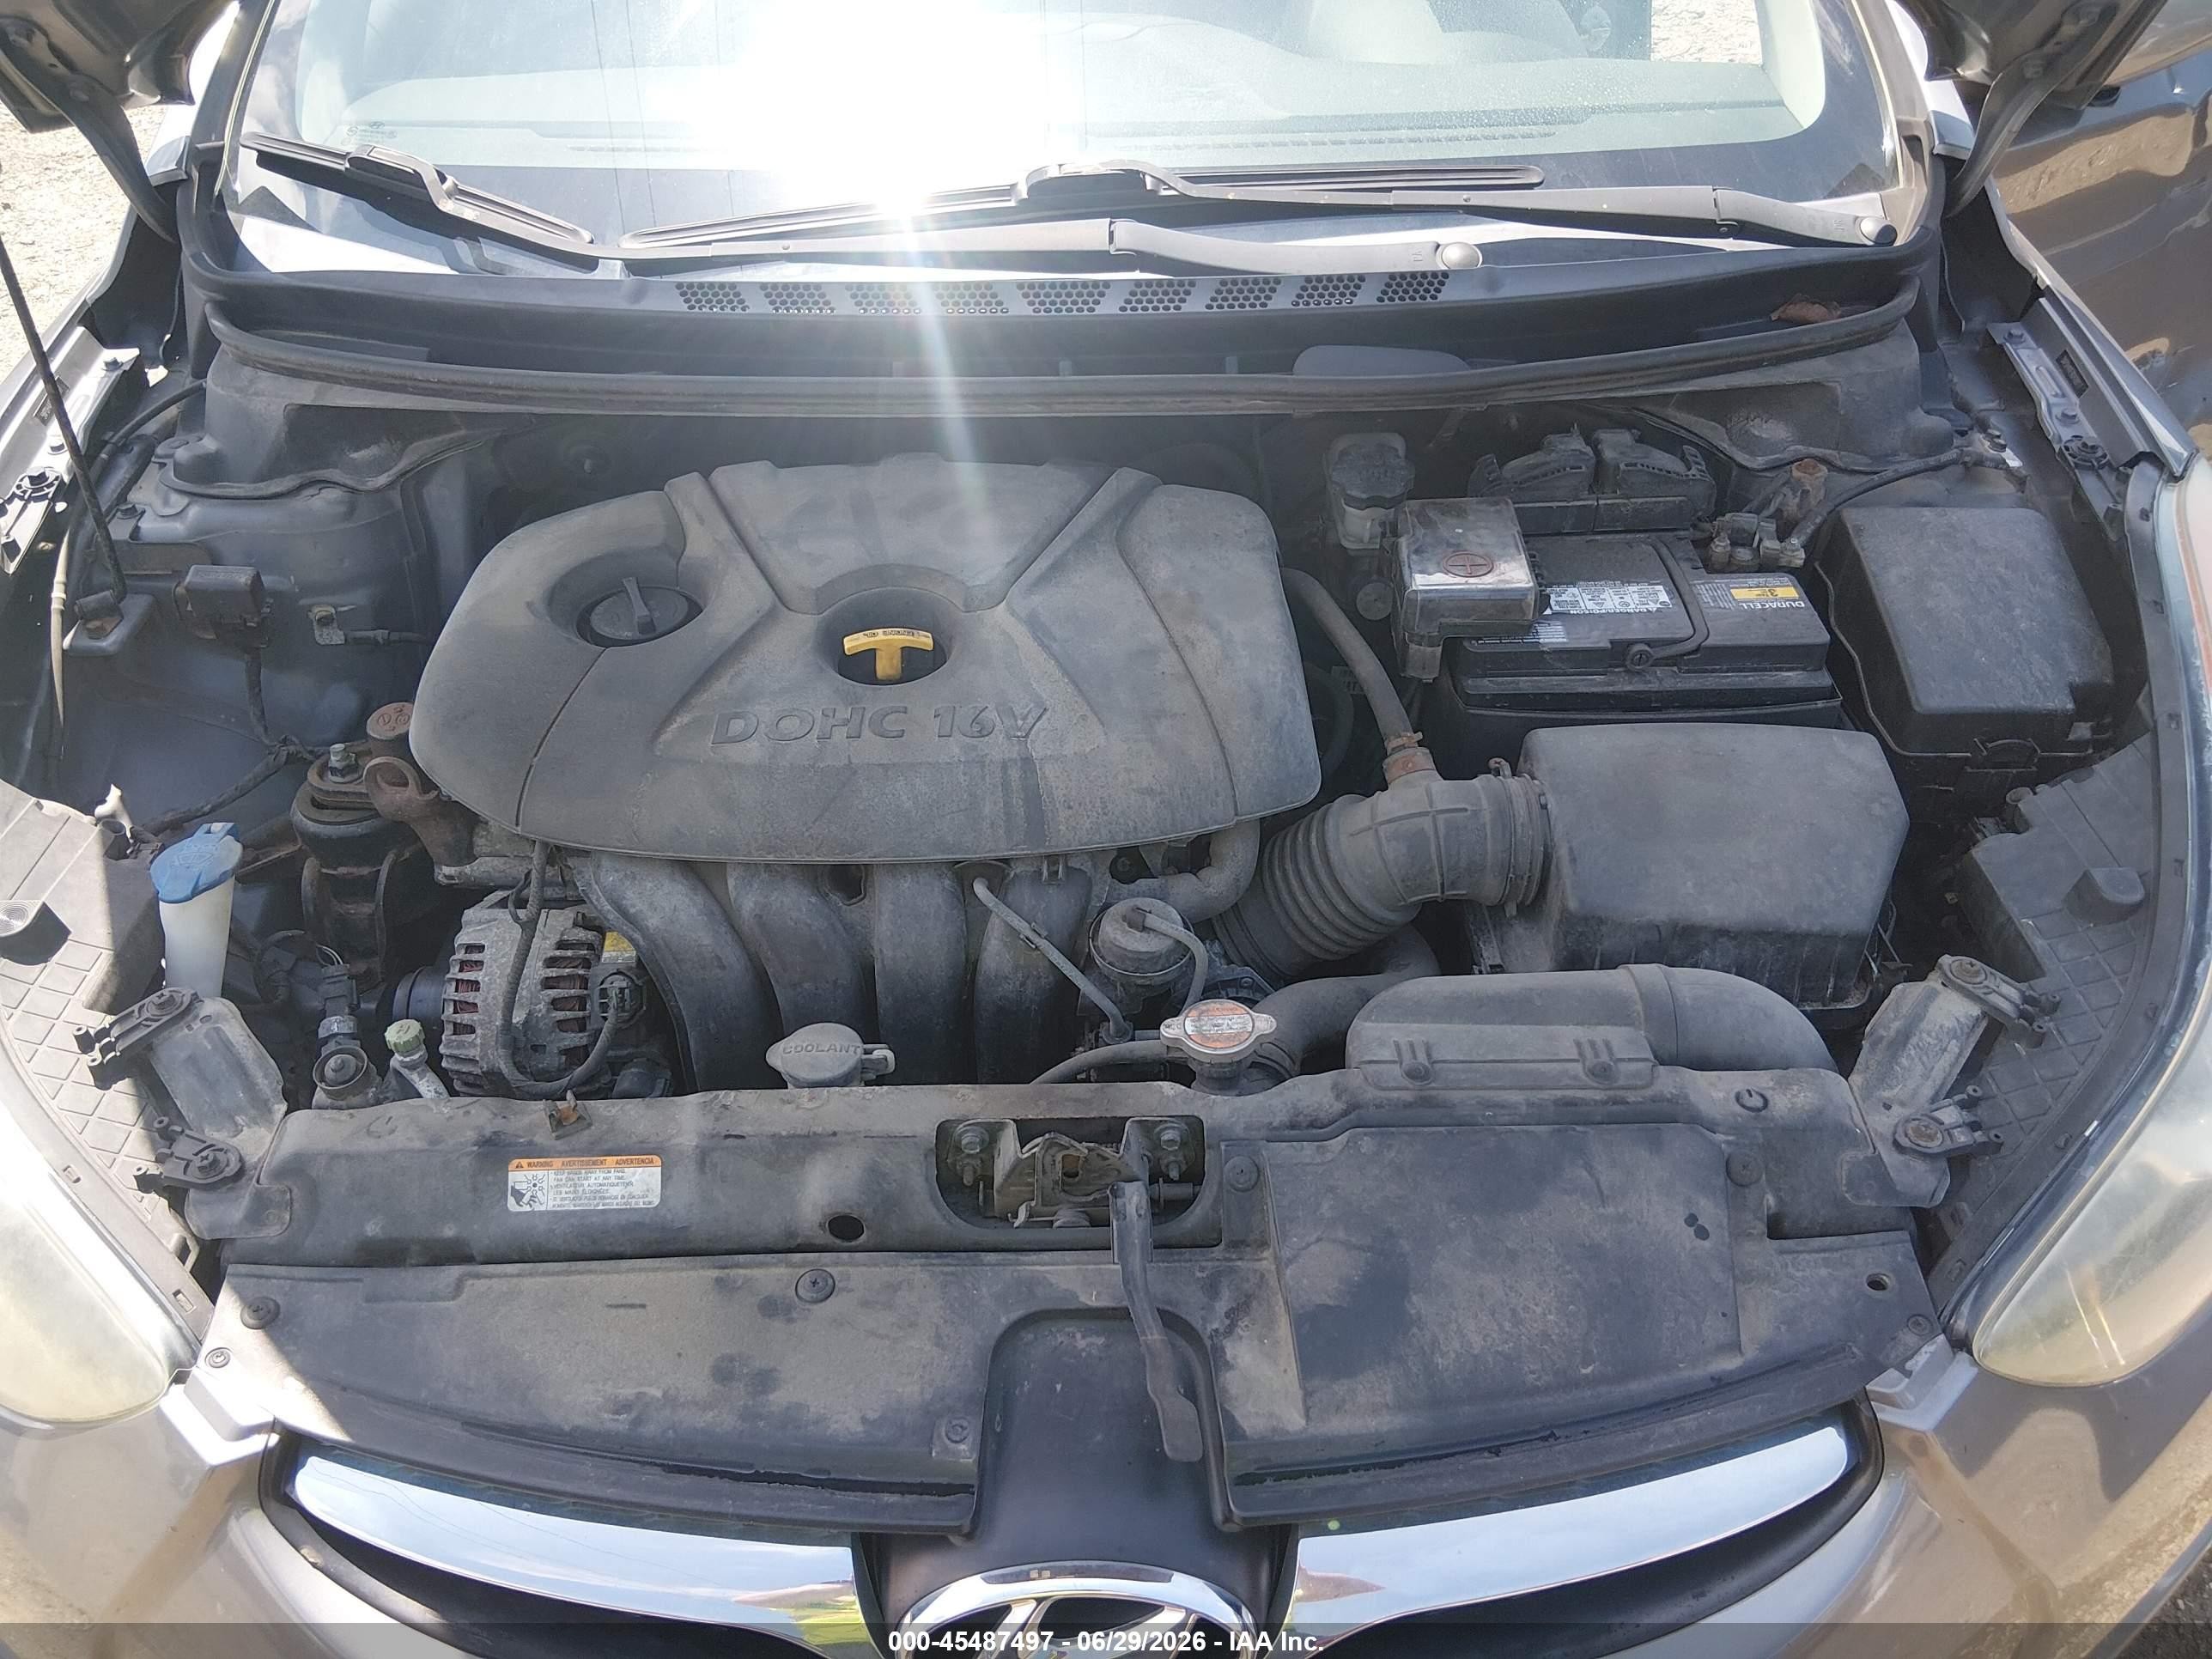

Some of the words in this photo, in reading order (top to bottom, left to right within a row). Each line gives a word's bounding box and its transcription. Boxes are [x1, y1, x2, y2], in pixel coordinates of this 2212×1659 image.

[1768, 587, 1778, 598] 3
[1738, 600, 1806, 611] DURACELL
[710, 705, 908, 745] DOHC
[933, 704, 1049, 741] 16V
[782, 1043, 860, 1055] COOLANT
[614, 1158, 654, 1166] ADVERTENCIA
